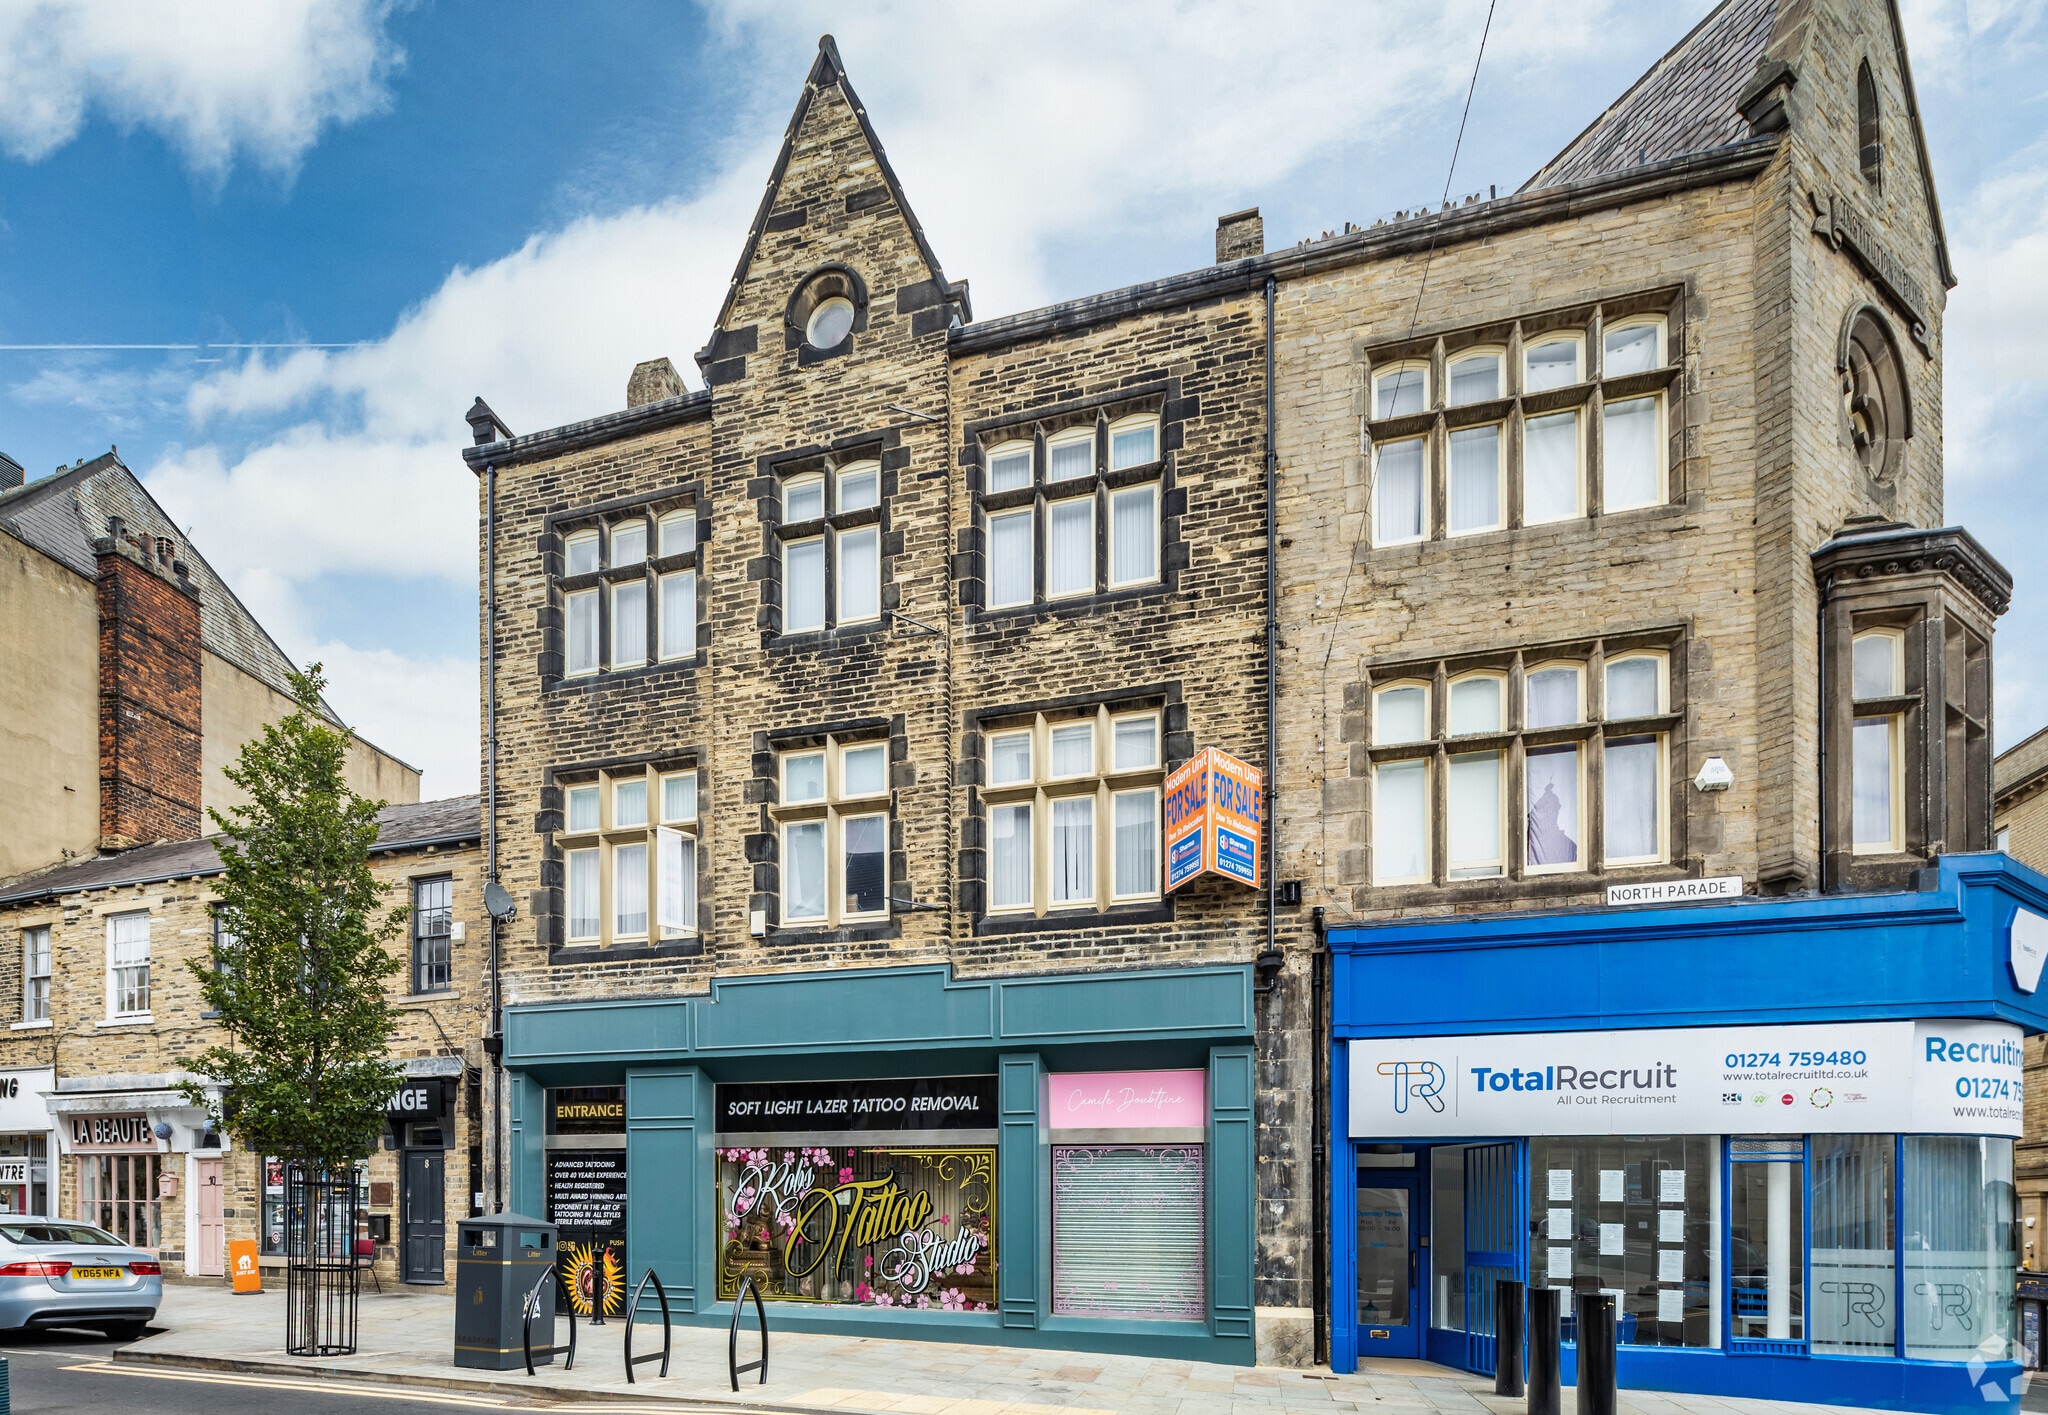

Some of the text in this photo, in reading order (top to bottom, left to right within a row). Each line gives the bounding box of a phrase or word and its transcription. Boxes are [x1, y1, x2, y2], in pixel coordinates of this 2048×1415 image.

[1166, 752, 1208, 793] Modern Unit
[1213, 751, 1261, 786] Modern Unit
[1166, 771, 1207, 829] FOR SALE
[1213, 771, 1260, 823] FOR SALE
[1219, 858, 1235, 873] 01274
[1611, 887, 1662, 901] NORTH
[1725, 1050, 1867, 1068] 01274 759480
[1471, 1061, 1677, 1092] TotalRecruit
[1723, 1069, 1868, 1081] www.totalrecruitltd.co.uk
[1557, 1093, 1677, 1105] All Out Recruitment
[1956, 1077, 2009, 1100] 01274
[557, 1104, 623, 1118] ENTRANCE
[728, 1095, 980, 1116] SOFT LIGHT LAZER TATTOO REMOVAL
[71, 1117, 152, 1144] LA BEAUTE
[209, 1175, 217, 1186] 10
[732, 1158, 816, 1219] Robs
[784, 1168, 933, 1279] Tattoo
[609, 1239, 625, 1247] PUSH
[880, 1225, 981, 1295] Studio
[76, 1269, 120, 1278] YD65 NFA
